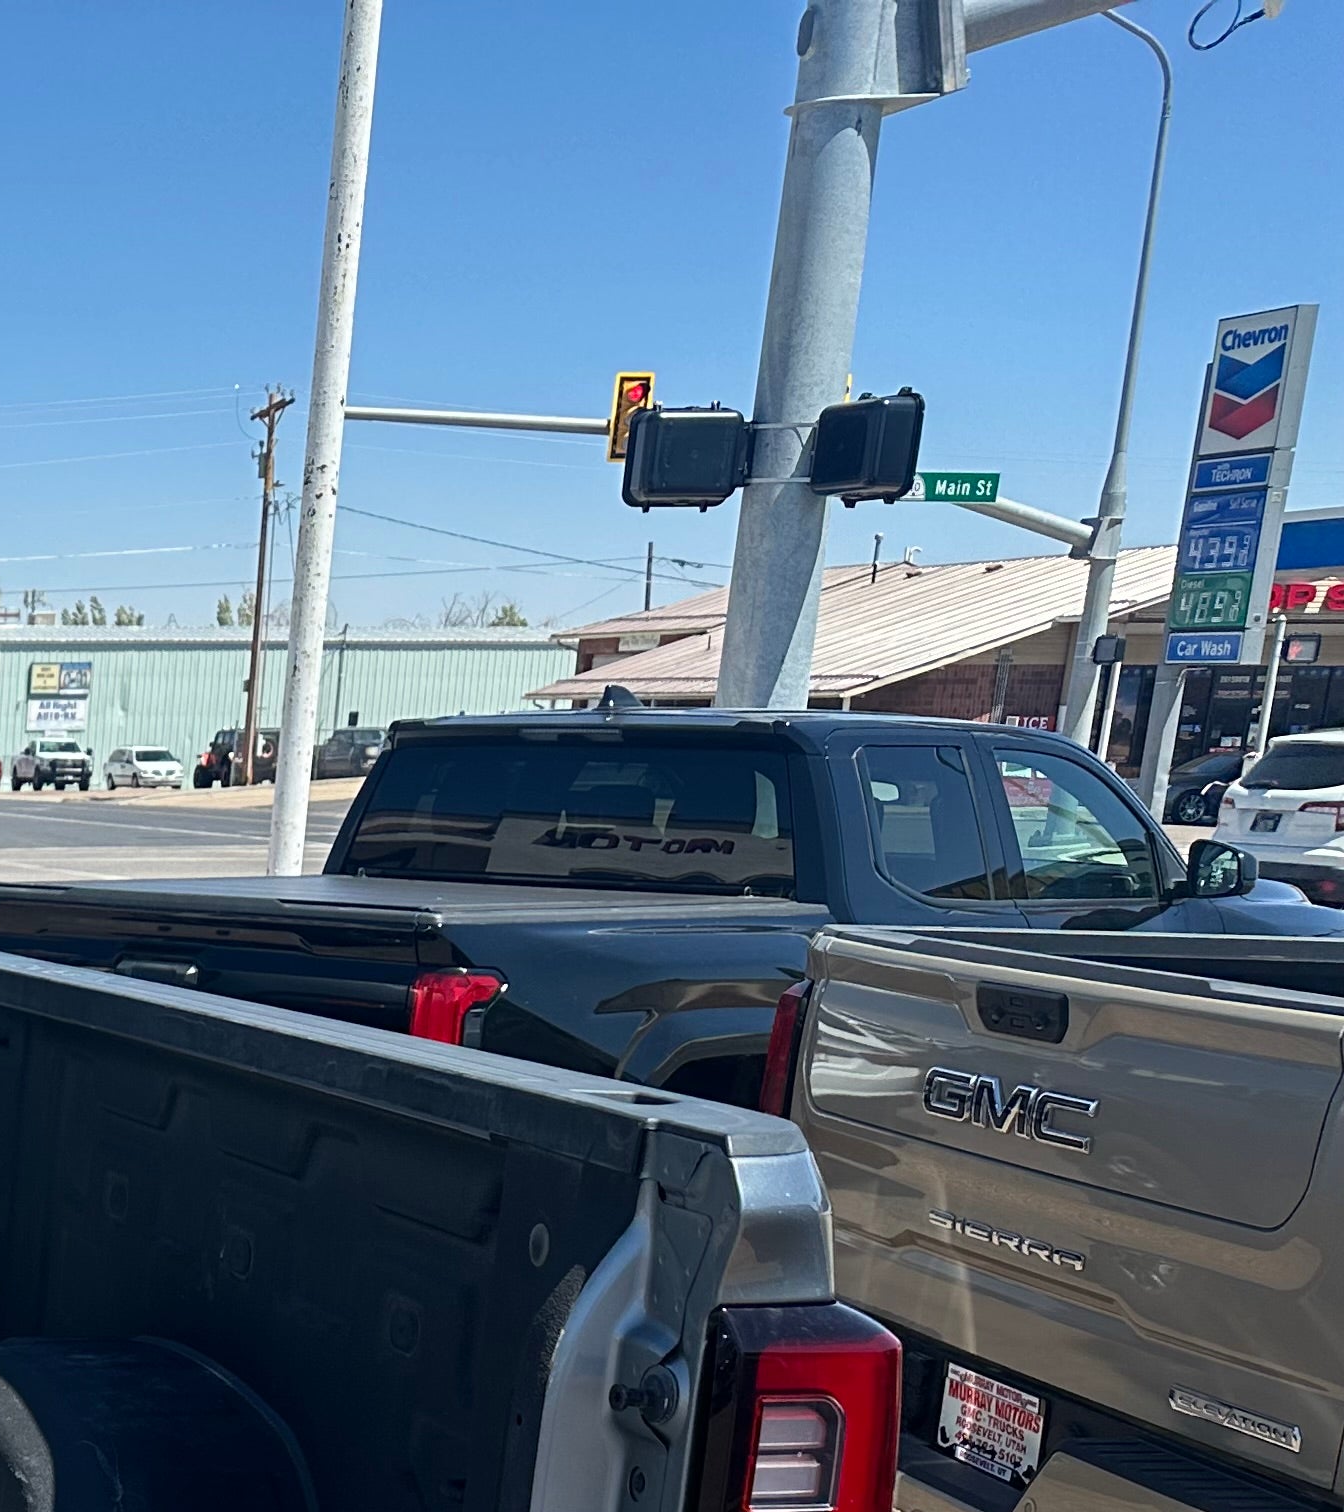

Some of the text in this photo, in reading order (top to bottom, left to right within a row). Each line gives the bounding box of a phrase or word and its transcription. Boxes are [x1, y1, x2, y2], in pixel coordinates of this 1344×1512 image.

[1221, 324, 1289, 352] Chevron
[1212, 468, 1253, 483] TECHRON
[935, 479, 993, 496] Main St
[1181, 579, 1205, 589] Diesel
[1177, 640, 1231, 656] Car Wash
[1022, 716, 1048, 729] ICE
[923, 1066, 1100, 1155] GMC
[928, 1208, 1086, 1272] SIERRA
[948, 1379, 1041, 1434] MURRAY MOTORS
[960, 1404, 982, 1422] GMC
[988, 1415, 1025, 1442] TRUCKS
[1178, 1394, 1287, 1443] ELEVATION
[1005, 1432, 1027, 1455] UTAH
[997, 1467, 1008, 1477] UT
